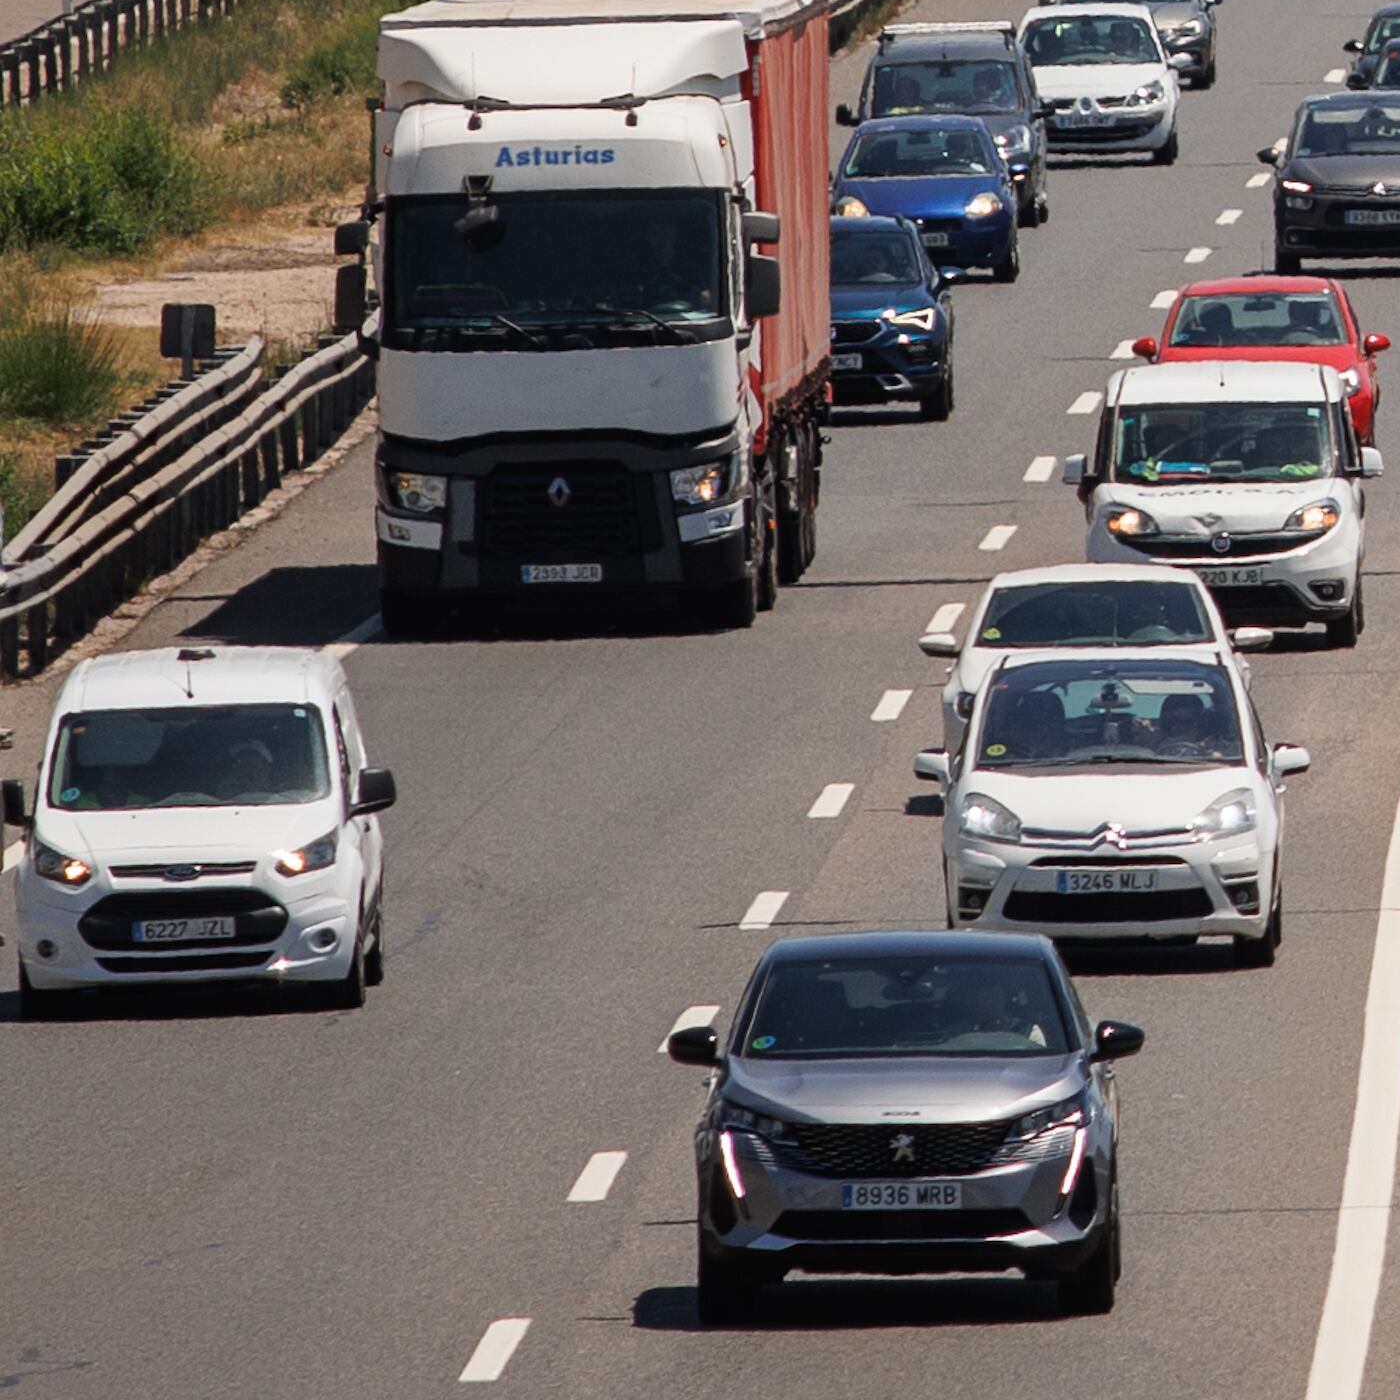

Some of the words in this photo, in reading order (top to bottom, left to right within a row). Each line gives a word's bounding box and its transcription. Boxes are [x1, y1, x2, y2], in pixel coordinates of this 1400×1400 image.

[496, 147, 615, 166] Asturias
[1201, 571, 1227, 585] 220
[1070, 873, 1114, 890] 3246
[145, 921, 188, 939] 6227
[199, 920, 231, 937] JZL
[857, 1185, 910, 1205] 8936
[916, 1185, 958, 1205] MRB
